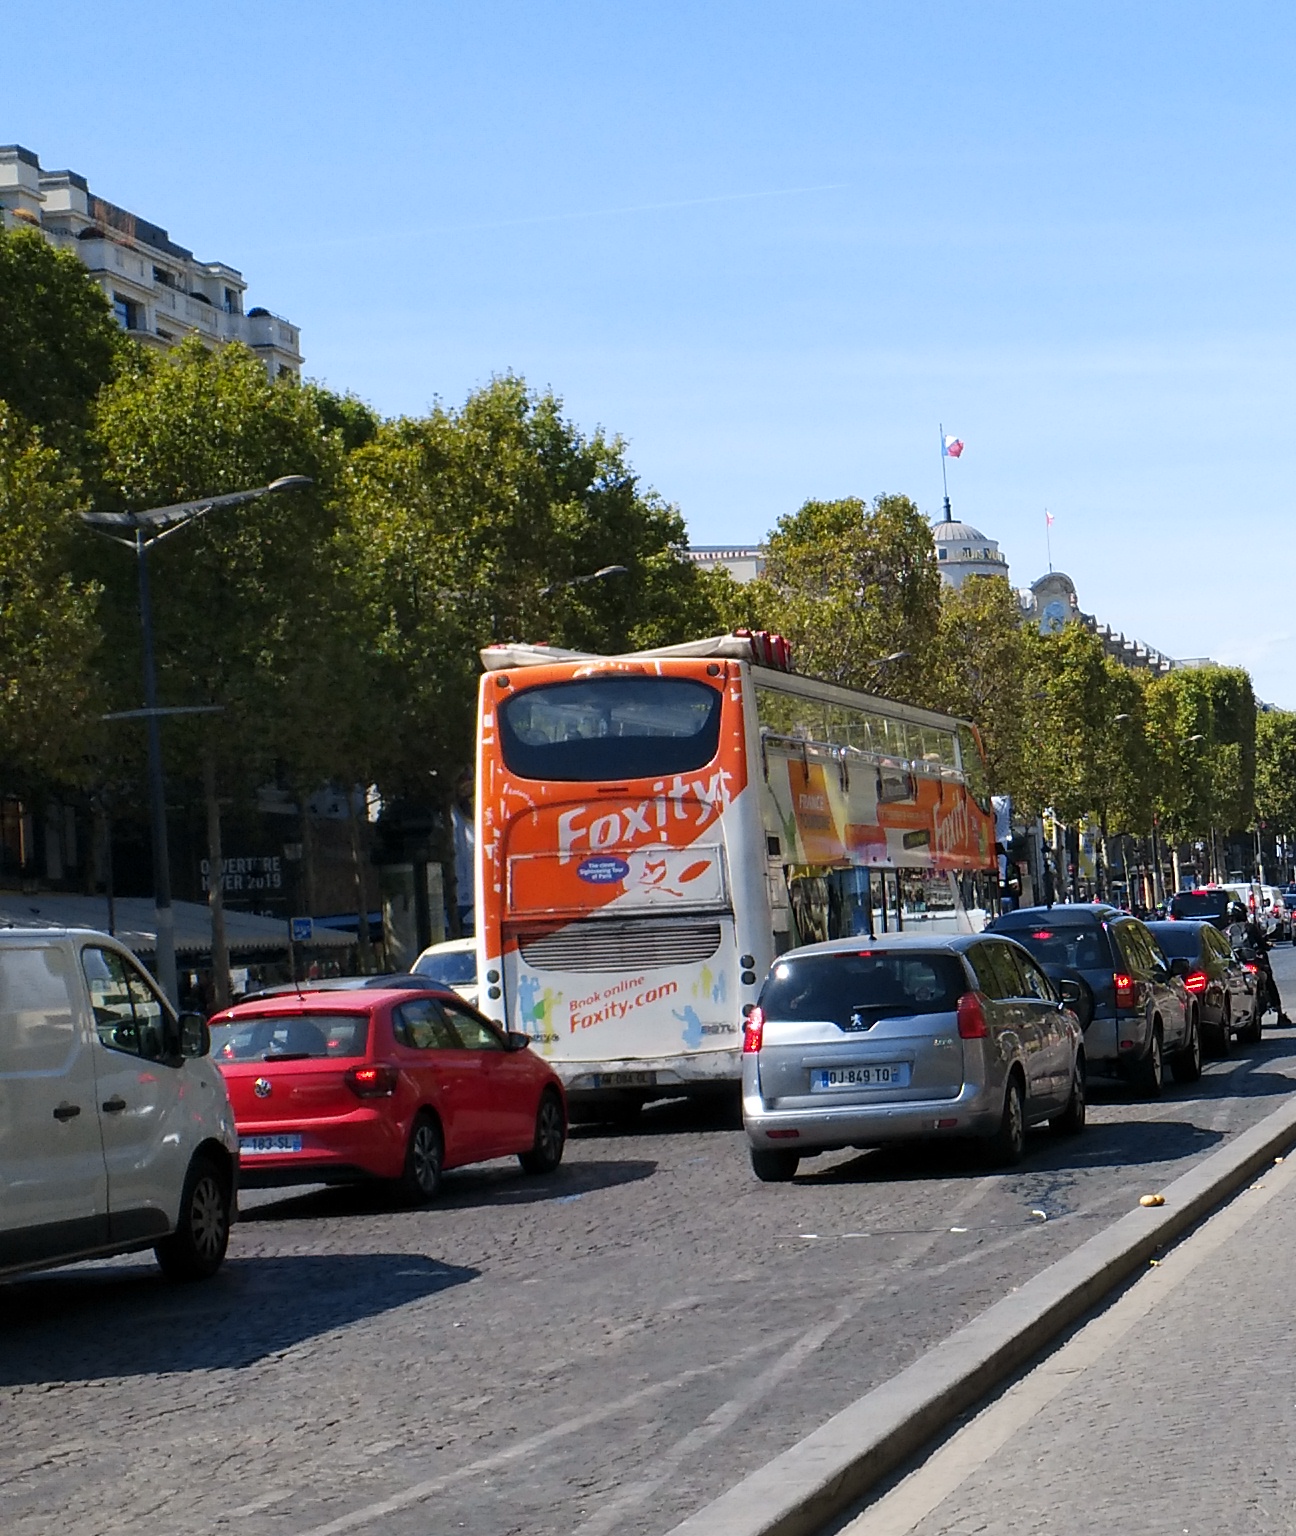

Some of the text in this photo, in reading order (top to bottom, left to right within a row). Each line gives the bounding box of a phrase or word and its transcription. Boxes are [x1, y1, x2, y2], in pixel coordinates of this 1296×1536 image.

[200, 856, 281, 875] OVERTRE
[202, 874, 242, 891] HVER
[569, 975, 646, 1013] Book online
[569, 980, 679, 1035] Foxity.com
